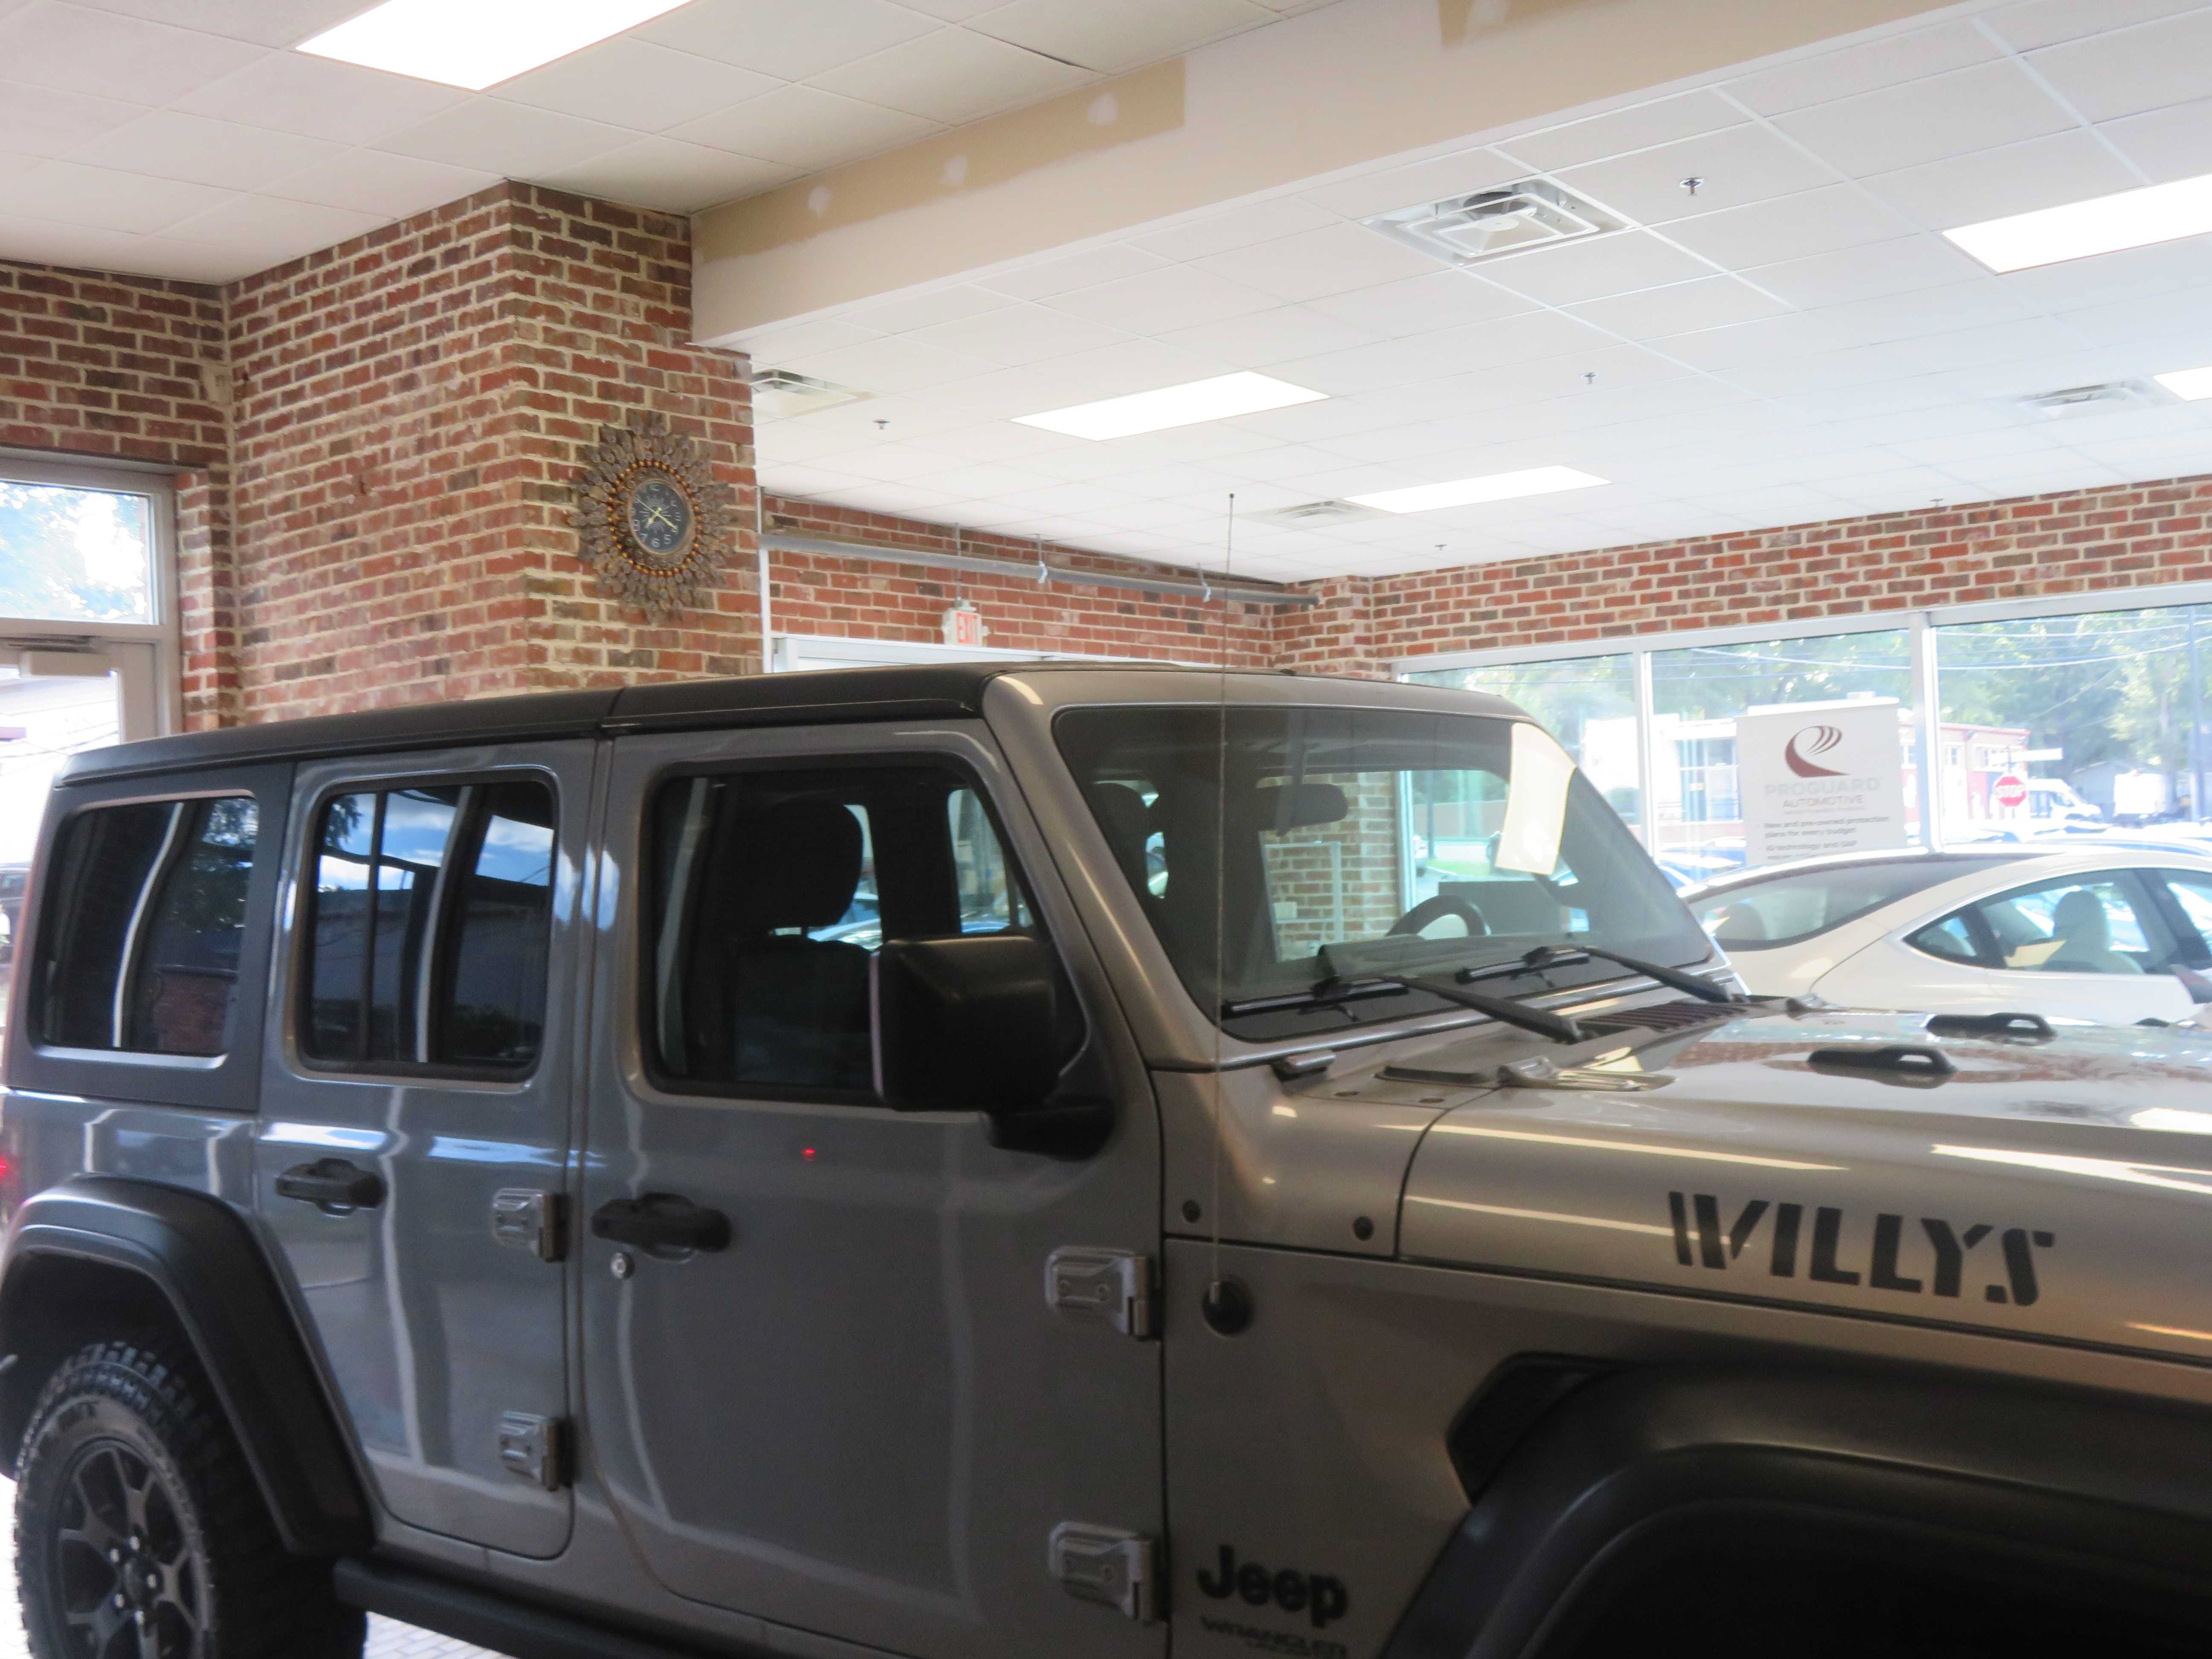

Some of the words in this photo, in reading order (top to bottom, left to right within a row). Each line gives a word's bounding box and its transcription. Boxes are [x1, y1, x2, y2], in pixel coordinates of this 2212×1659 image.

[651, 537, 660, 548] 6
[664, 534, 672, 545] 5
[956, 612, 979, 643] EXIT
[1764, 777, 1881, 797] PROGUARD
[1993, 784, 2027, 800] STOP
[1782, 794, 1864, 808] AUTOMOTIVE
[1668, 1191, 2055, 1307] WILLYS
[1196, 1543, 1348, 1629] Jeep
[1200, 1615, 1348, 1659] WRANGLER
